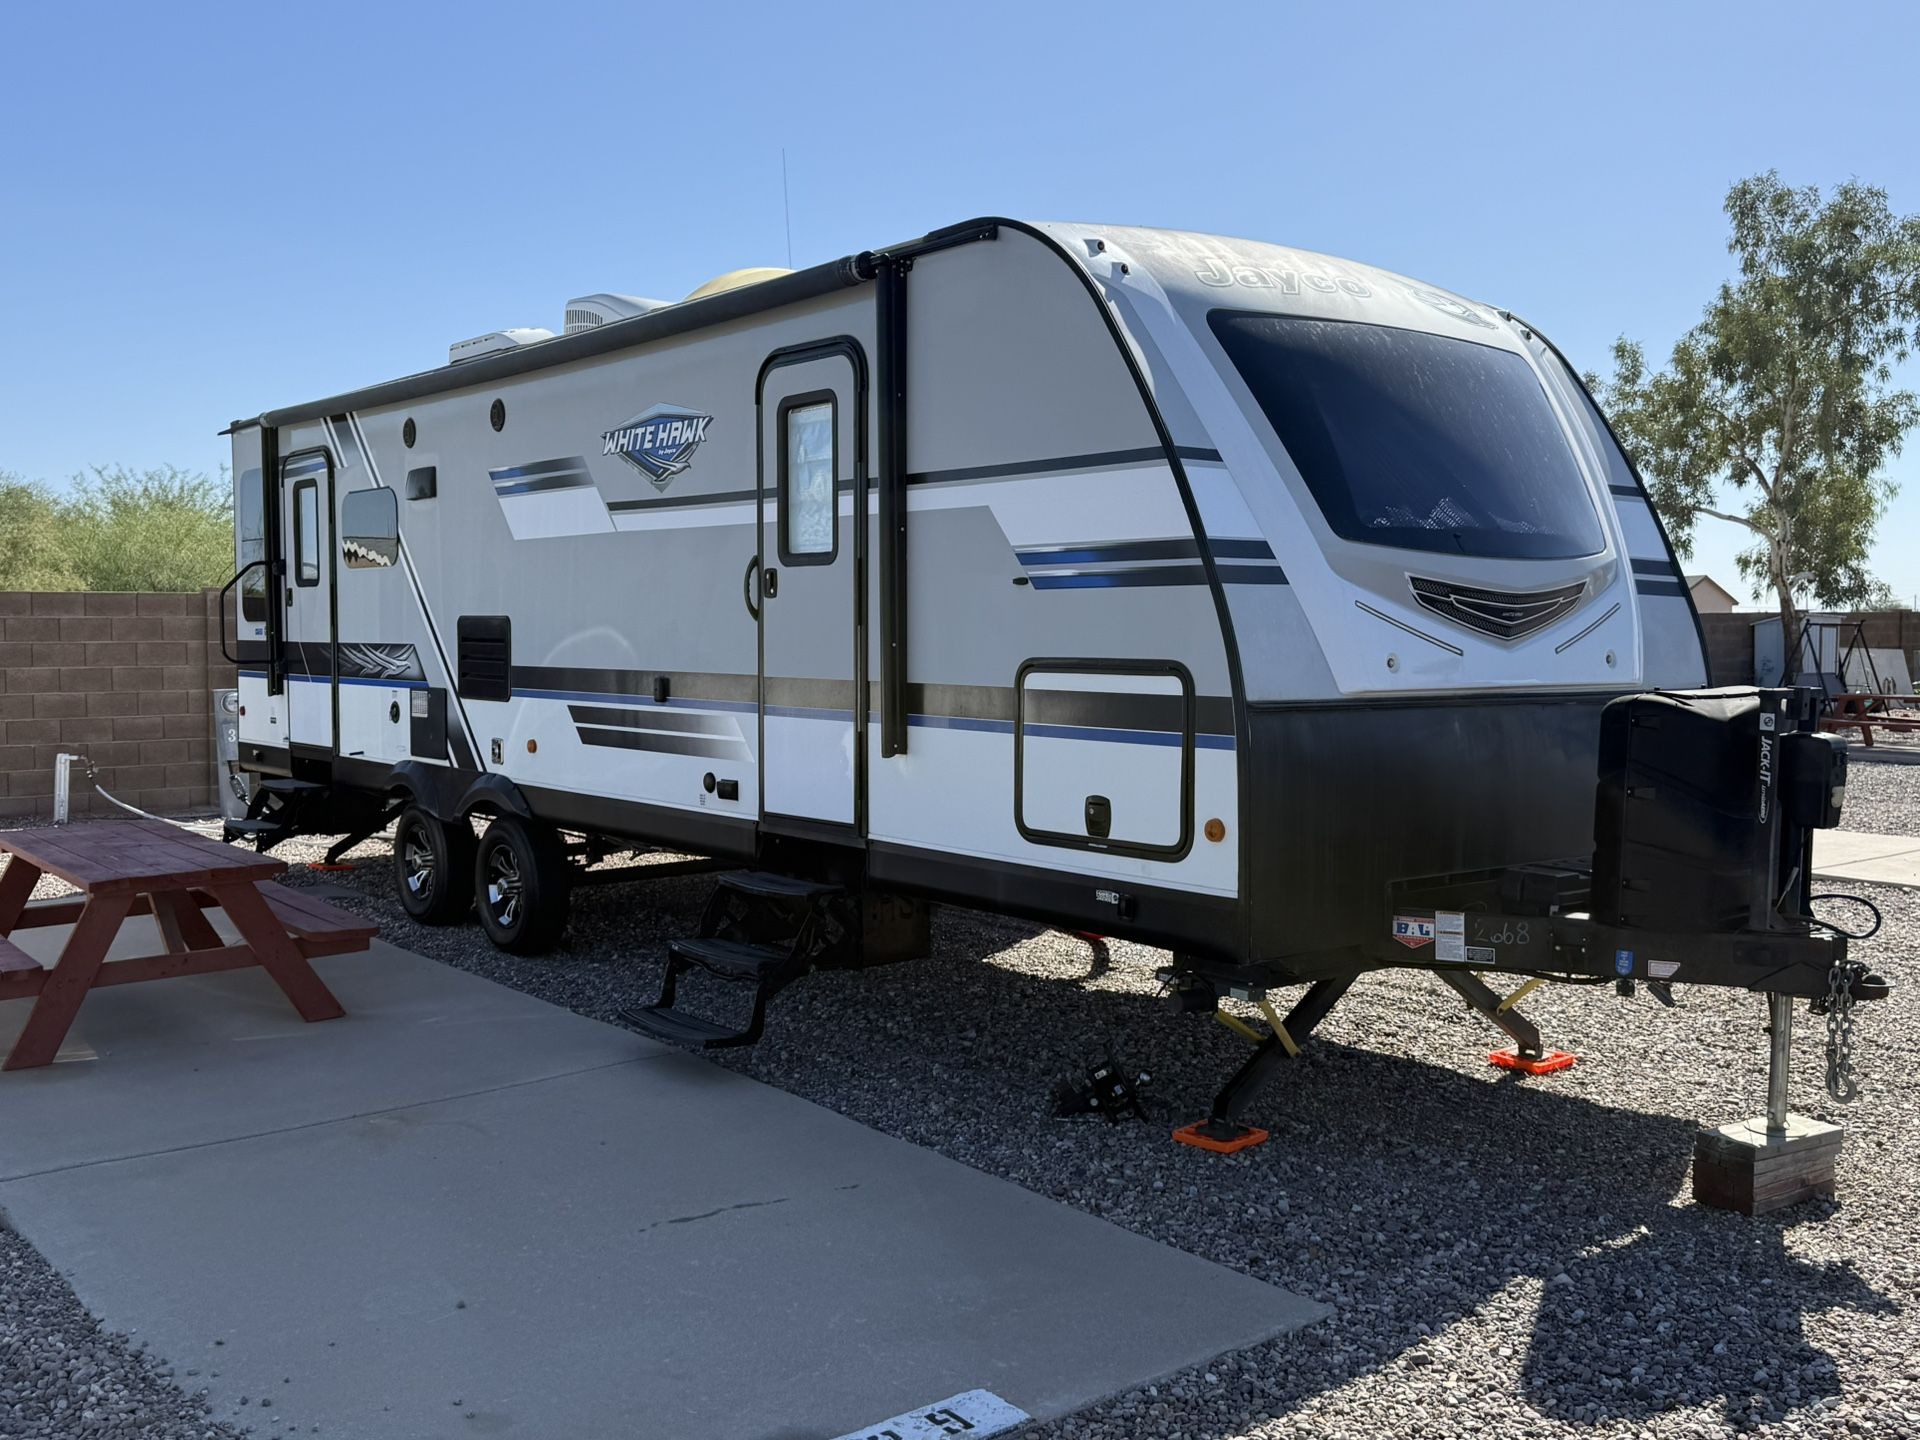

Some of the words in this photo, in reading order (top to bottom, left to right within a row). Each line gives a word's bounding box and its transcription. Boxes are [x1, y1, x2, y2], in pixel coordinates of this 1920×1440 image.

[1195, 258, 1371, 297] Jayco
[602, 425, 655, 456] WHITE
[655, 416, 714, 448] HAWK
[1760, 735, 1773, 787] JACK-IT
